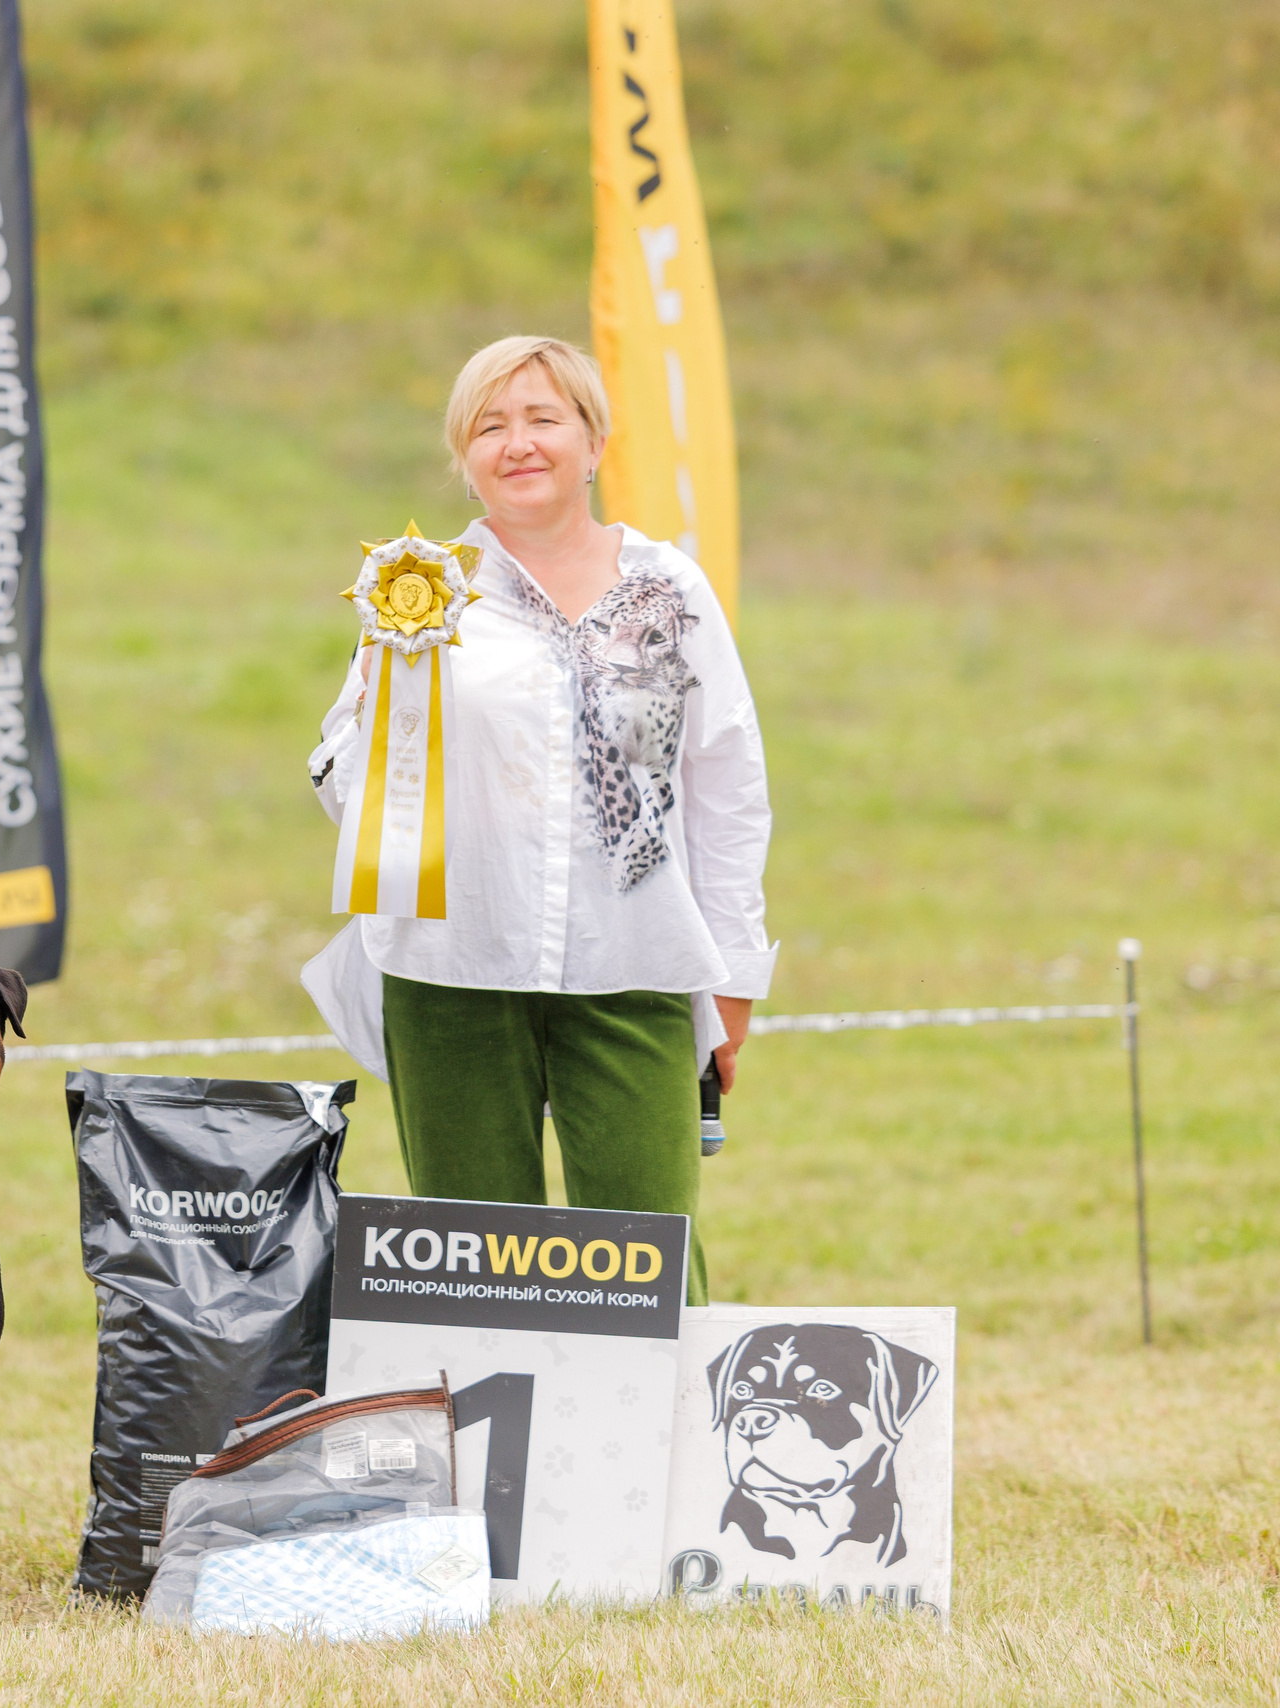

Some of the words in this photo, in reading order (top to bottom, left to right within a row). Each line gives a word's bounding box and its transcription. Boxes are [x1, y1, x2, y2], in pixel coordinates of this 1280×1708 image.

[130, 1214, 231, 1234] ПОЛНОРАЦИОННЫЙ
[363, 1226, 663, 1283] KORWOOD
[361, 1277, 542, 1302] ПОЛНОРАЦИОННЫЙ
[544, 1286, 605, 1306] СУХОЙ
[607, 1292, 658, 1309] КОРМ
[141, 1452, 192, 1463] ГОВЯДИНА
[451, 1372, 535, 1580] 1
